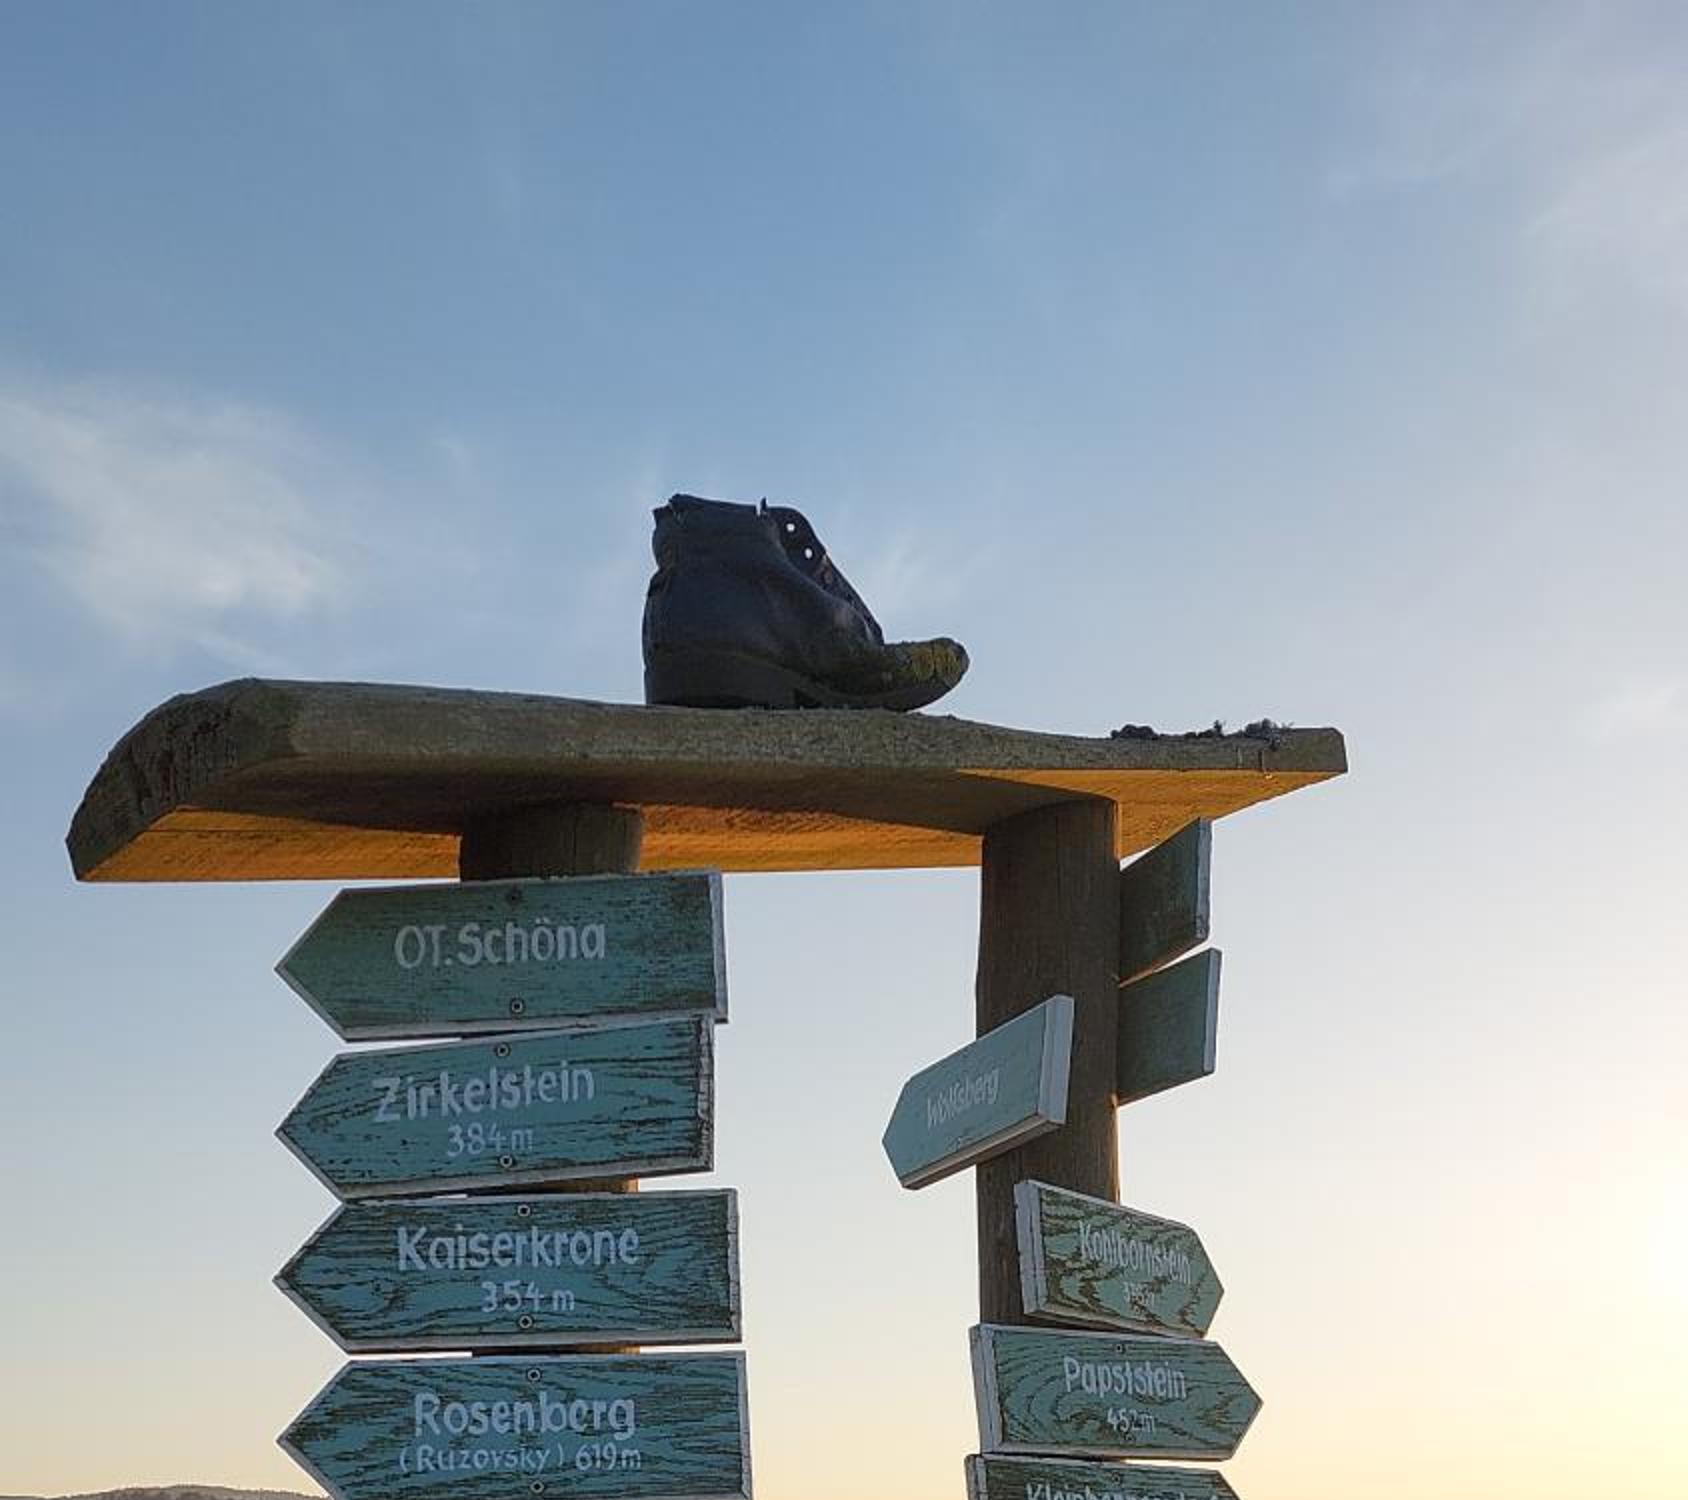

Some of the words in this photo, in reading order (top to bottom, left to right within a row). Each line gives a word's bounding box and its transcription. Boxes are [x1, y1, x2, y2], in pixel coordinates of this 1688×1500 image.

[370, 1059, 596, 1123] Zirkelstein
[396, 1223, 641, 1271] Kaiserkrone
[1062, 1355, 1187, 1399] Papststein
[413, 1390, 637, 1441] Rosenberg
